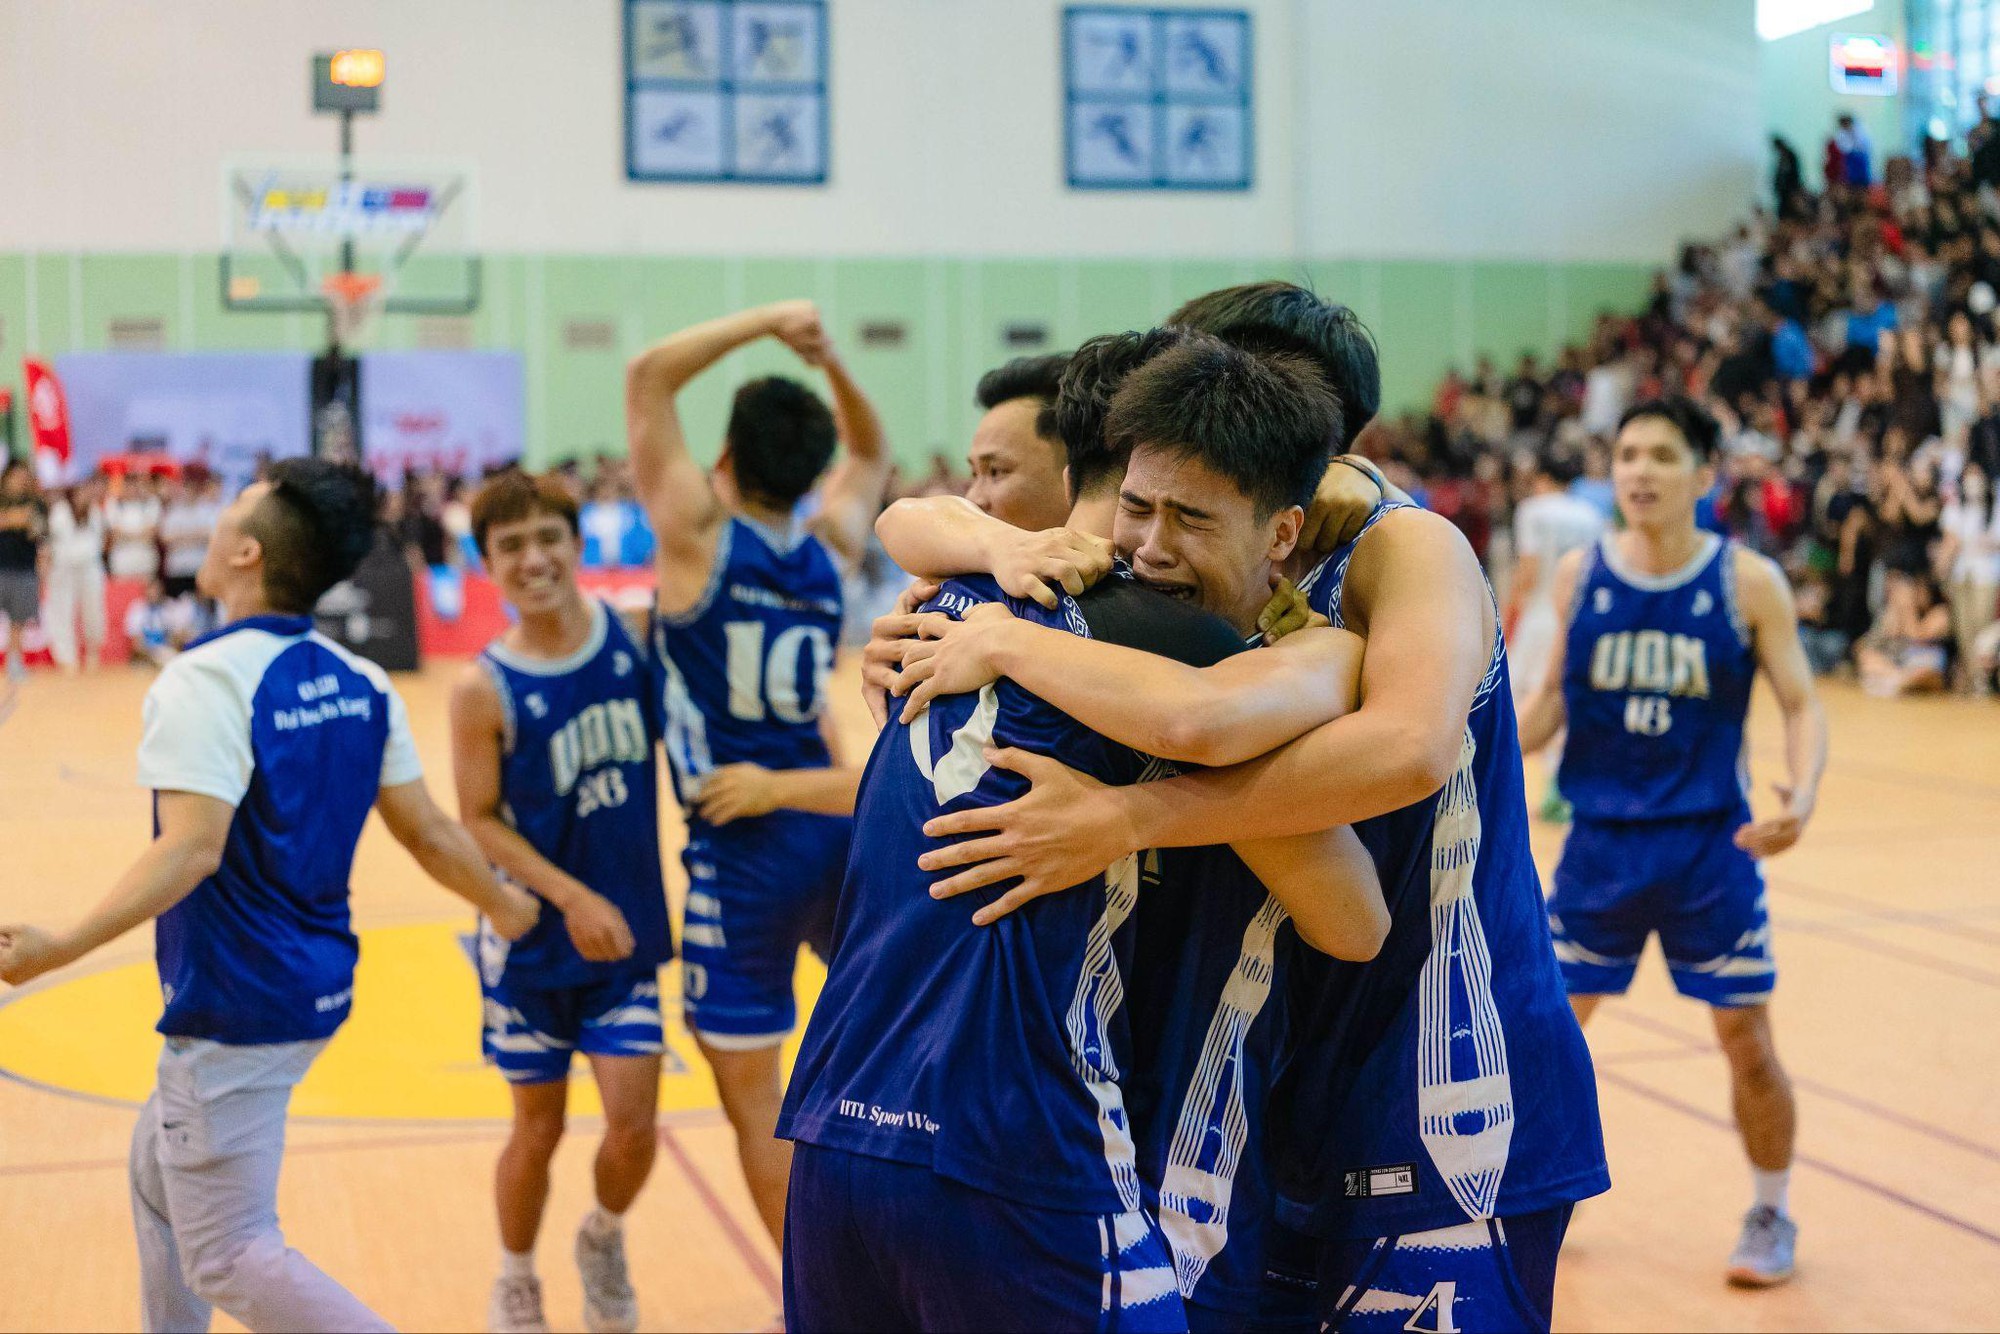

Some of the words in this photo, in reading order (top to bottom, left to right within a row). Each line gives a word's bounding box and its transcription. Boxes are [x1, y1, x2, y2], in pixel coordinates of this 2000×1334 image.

[723, 621, 833, 724] 10
[869, 1105, 906, 1127] Sport
[1404, 1281, 1461, 1333] 4
